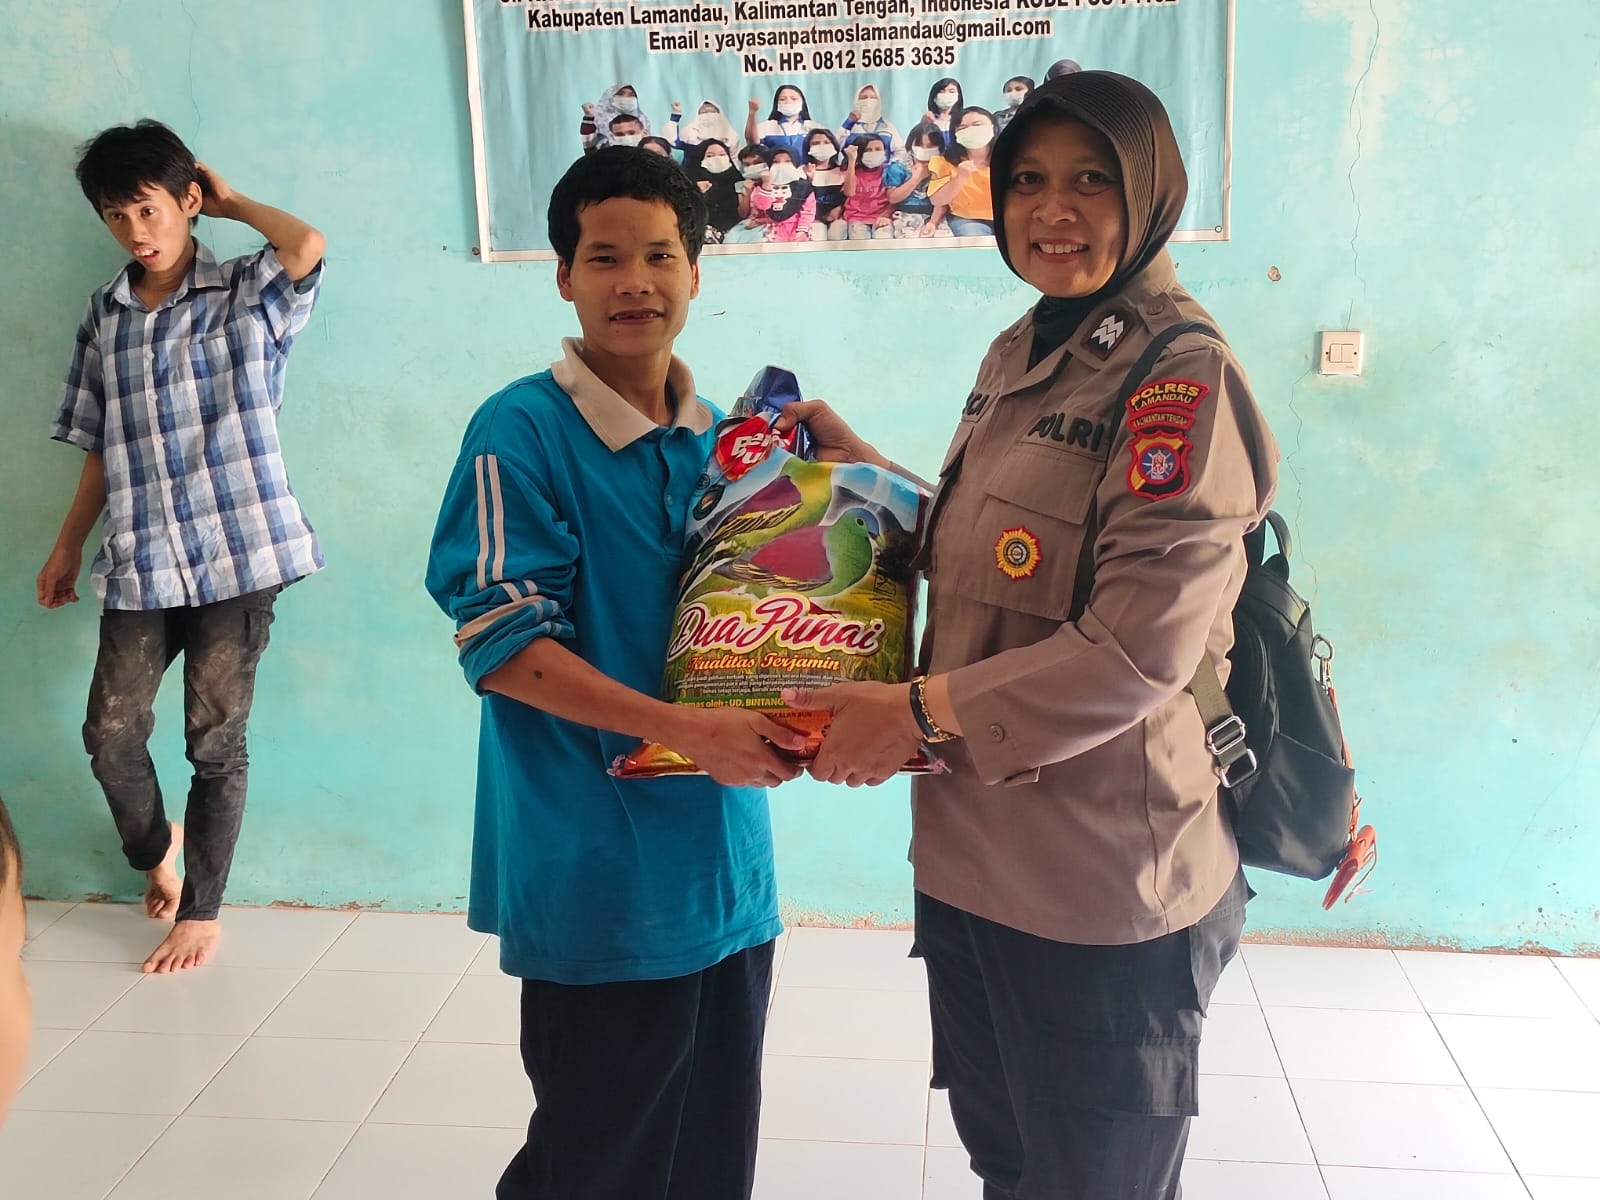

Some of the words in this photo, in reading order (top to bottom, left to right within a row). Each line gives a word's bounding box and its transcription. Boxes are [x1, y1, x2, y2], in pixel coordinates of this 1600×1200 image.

[528, 8, 624, 31] Kabupaten
[630, 6, 729, 26] Lamandau,
[735, 0, 838, 21] Kalimantan
[845, 0, 915, 19] Tengah,
[649, 31, 699, 50] Email
[715, 17, 1051, 53] yayasanpatmoslamandau@gmail.com
[744, 53, 774, 73] No.
[779, 51, 807, 72] HP.
[812, 49, 856, 70] 0812
[861, 47, 905, 68] 5685
[911, 45, 956, 66] 3635
[1131, 383, 1200, 406] POLRES
[1134, 393, 1193, 411] LAMANDAU
[667, 604, 745, 663] Dua
[737, 594, 885, 653] Punai
[687, 655, 756, 672] Kualitas
[760, 652, 841, 672] Terjamin
[745, 697, 784, 707] BINTANG
